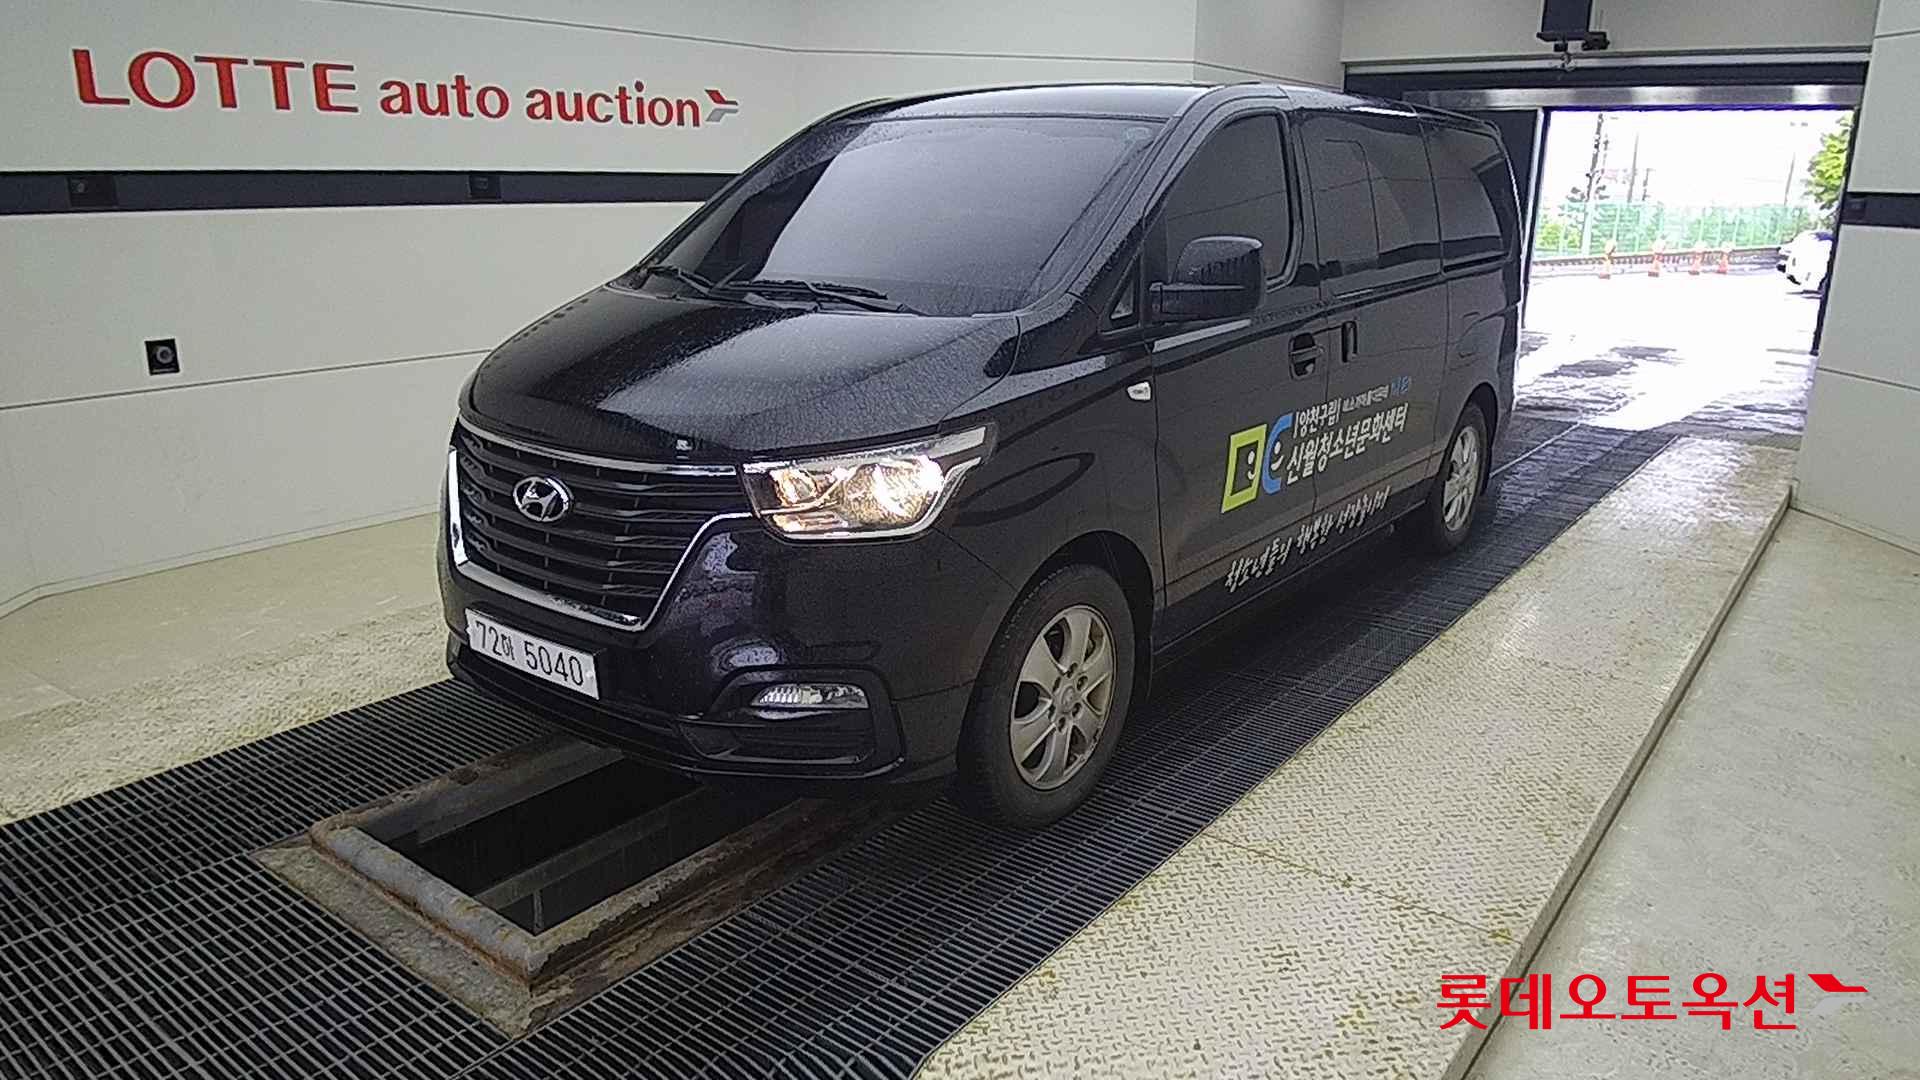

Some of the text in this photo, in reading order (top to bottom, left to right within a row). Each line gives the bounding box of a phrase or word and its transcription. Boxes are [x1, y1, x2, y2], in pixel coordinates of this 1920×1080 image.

[71, 48, 701, 128] LOTTE auto auction
[1286, 402, 1409, 485] 신월청소년문화센터
[523, 640, 584, 686] 5040
